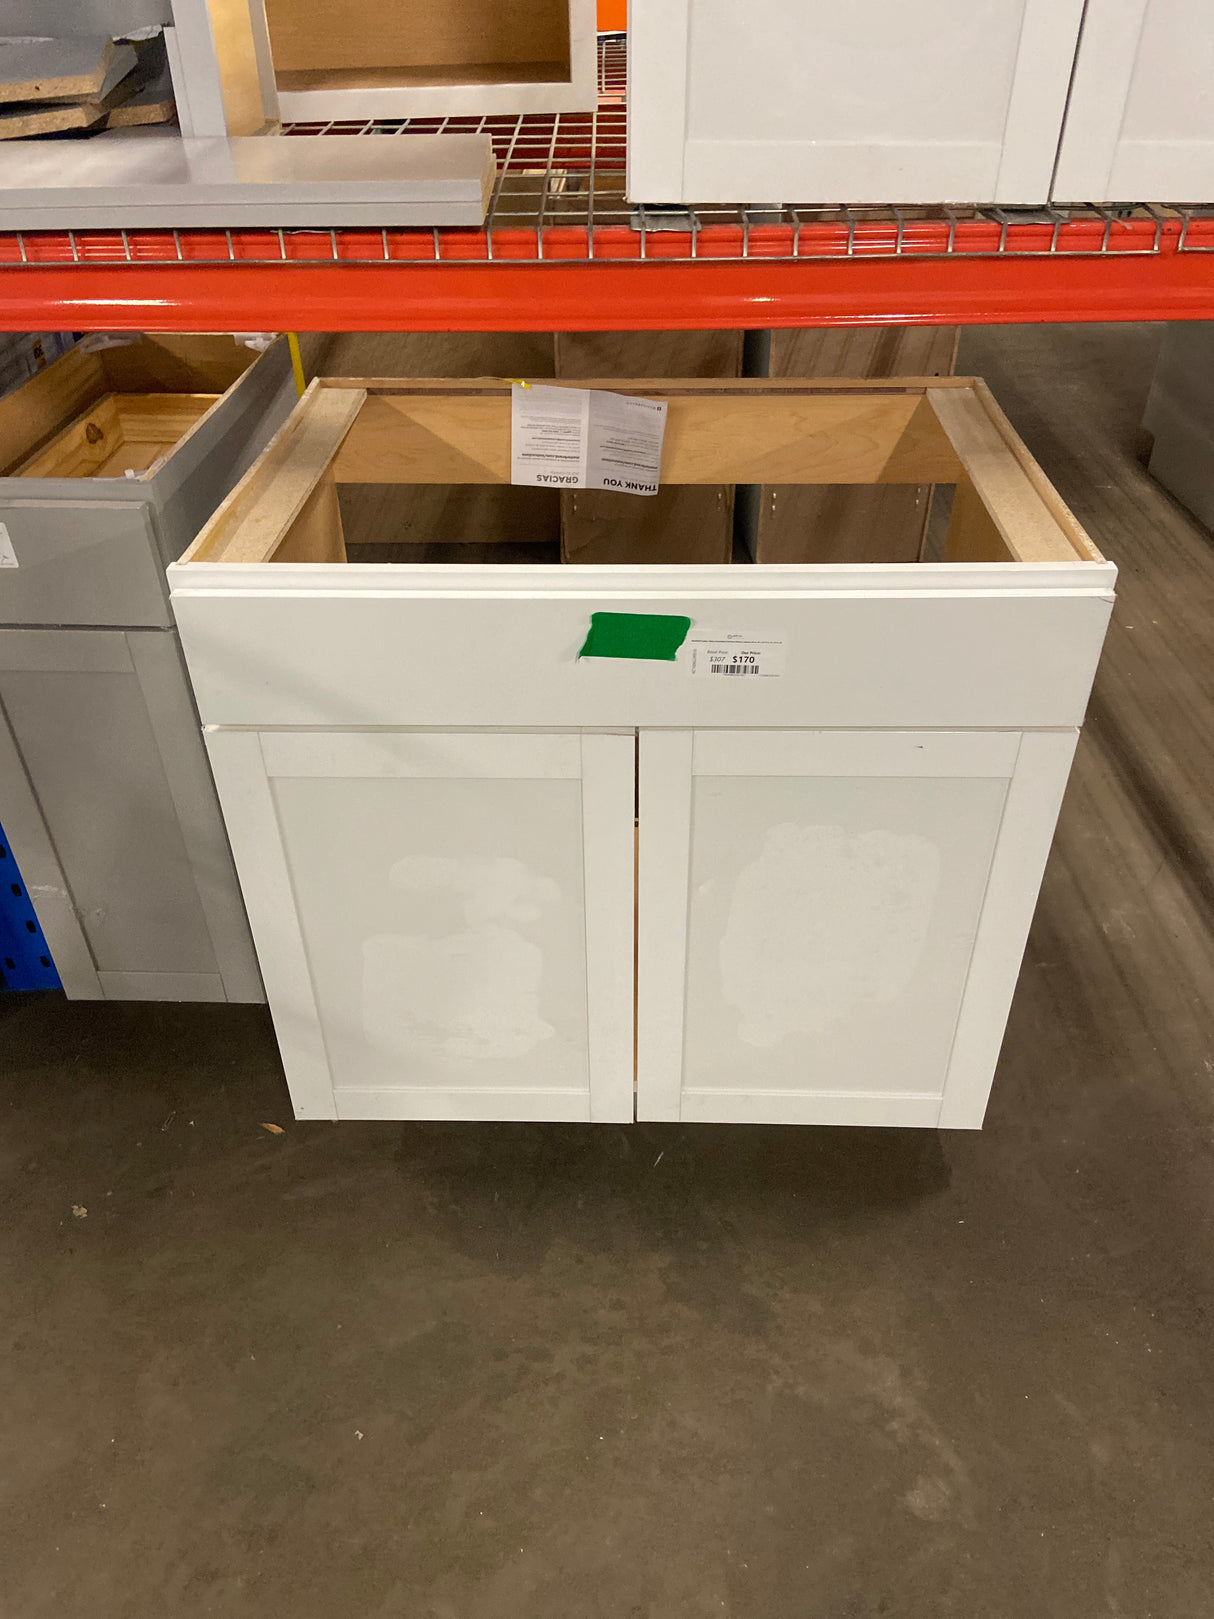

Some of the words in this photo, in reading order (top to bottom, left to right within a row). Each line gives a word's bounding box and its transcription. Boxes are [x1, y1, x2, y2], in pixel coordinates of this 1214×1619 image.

[536, 474, 579, 484] GRACIAS
[603, 478, 623, 488] YOU
[625, 482, 657, 492] THANK
[732, 655, 755, 664] $170
